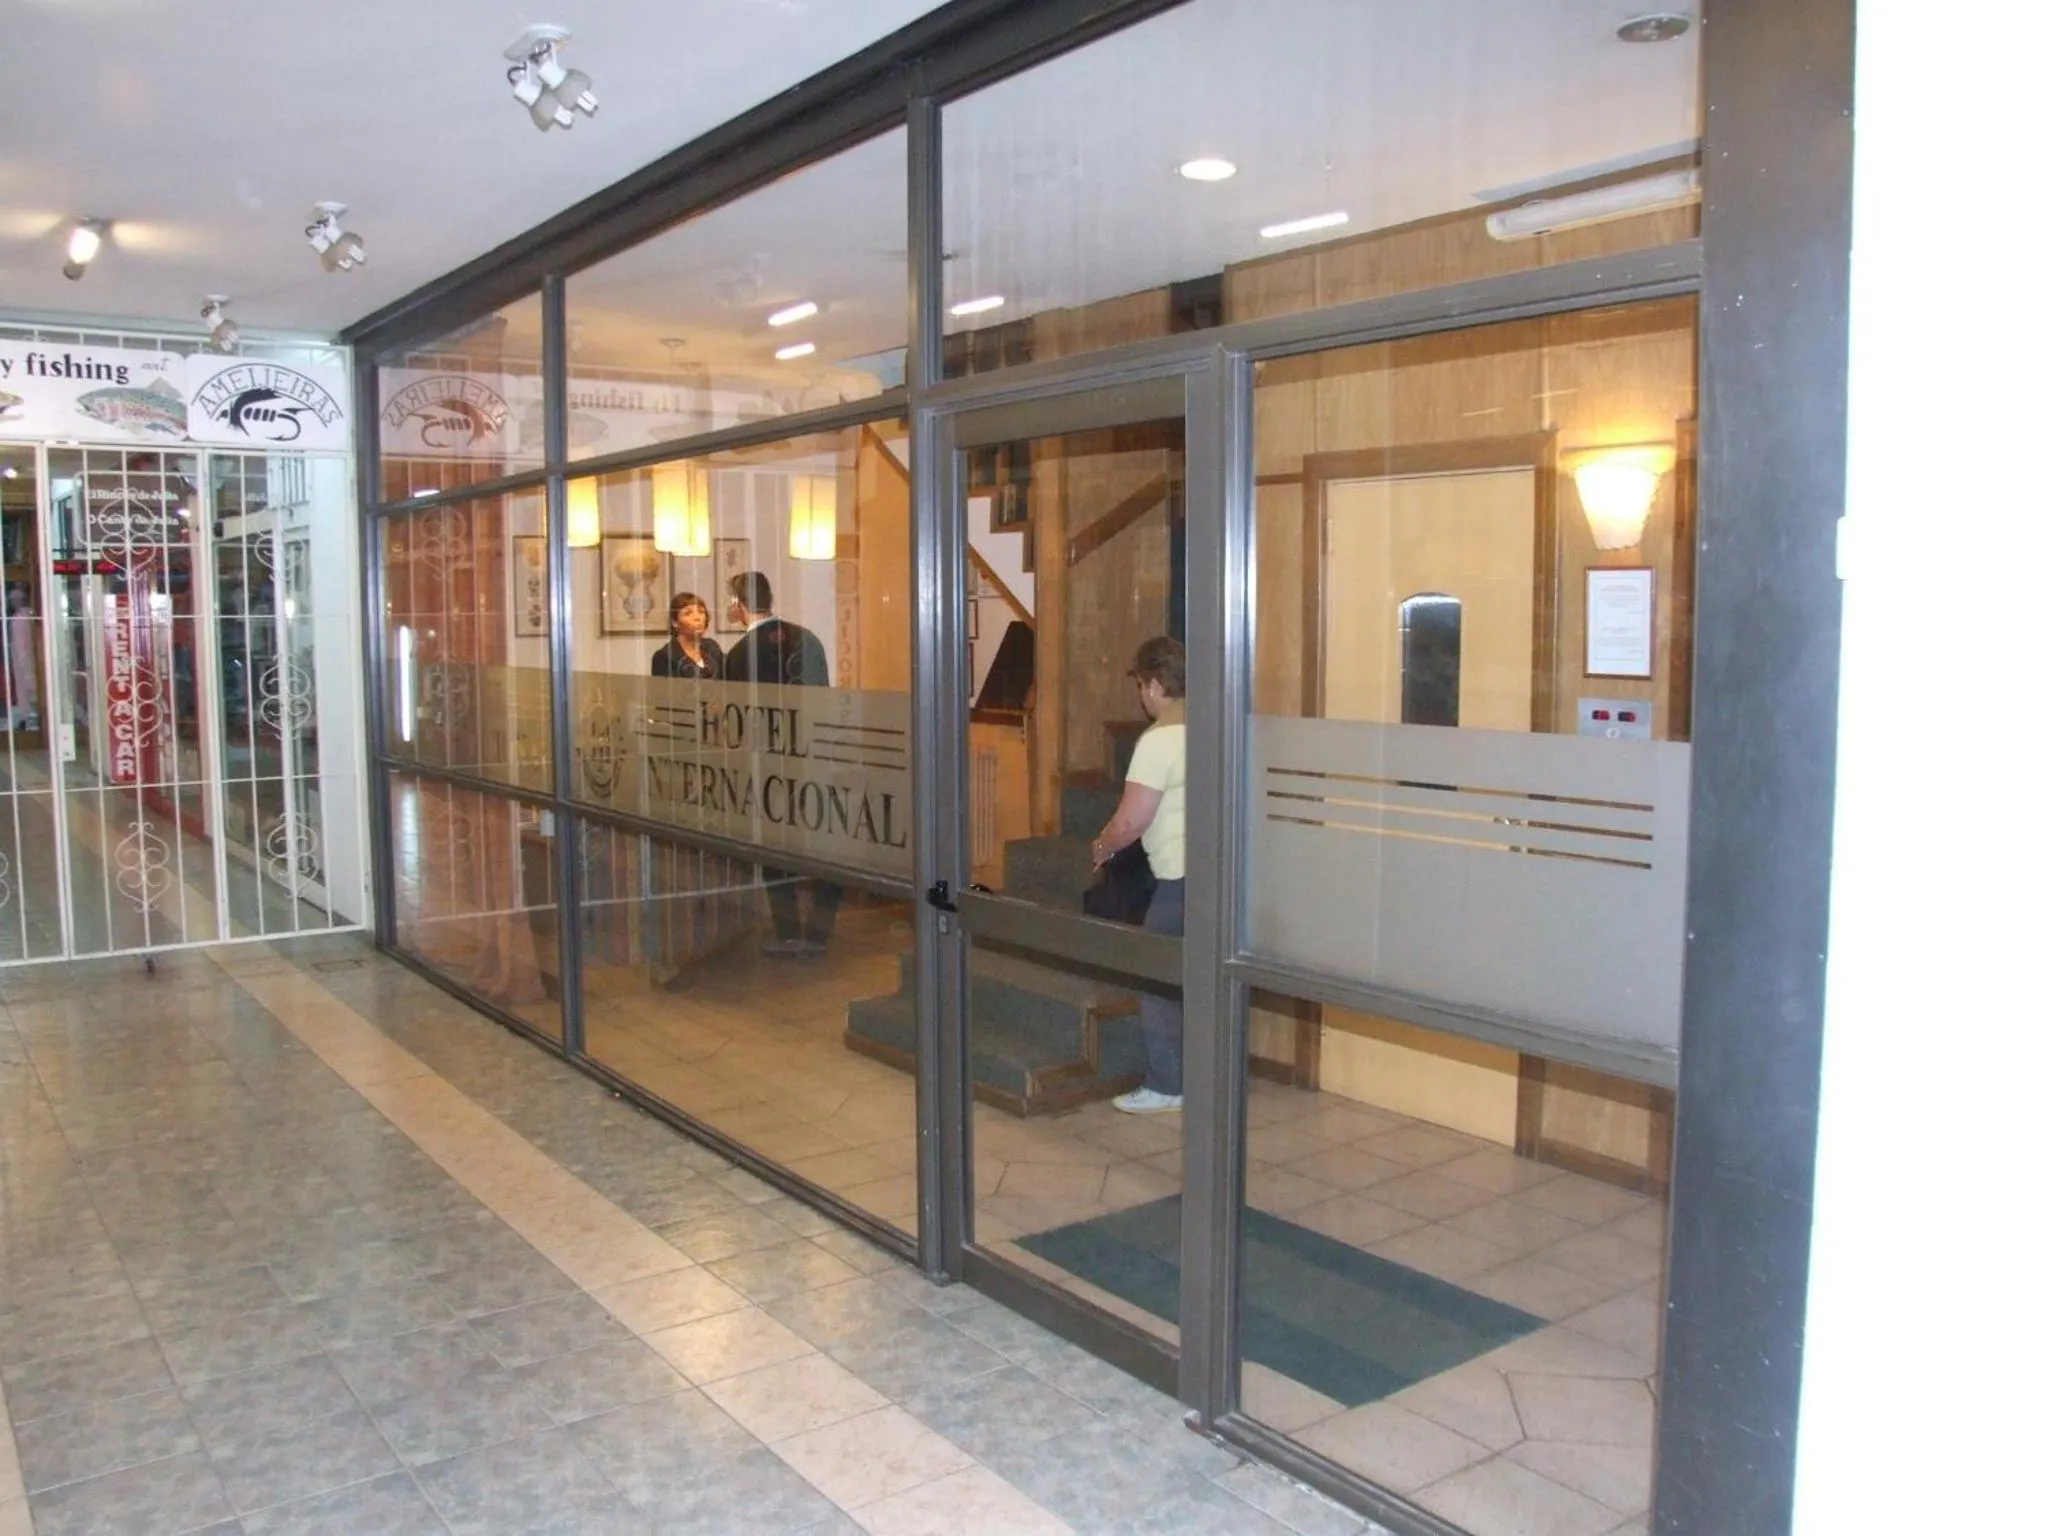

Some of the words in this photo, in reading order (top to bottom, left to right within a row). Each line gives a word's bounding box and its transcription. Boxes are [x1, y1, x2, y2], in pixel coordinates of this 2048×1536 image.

[26, 351, 131, 385] fishing
[197, 367, 343, 425] AMEIJEIRAS
[116, 723, 136, 777] CAR
[700, 701, 809, 760] HOTEL
[645, 755, 907, 849] NTERNACIONAL
